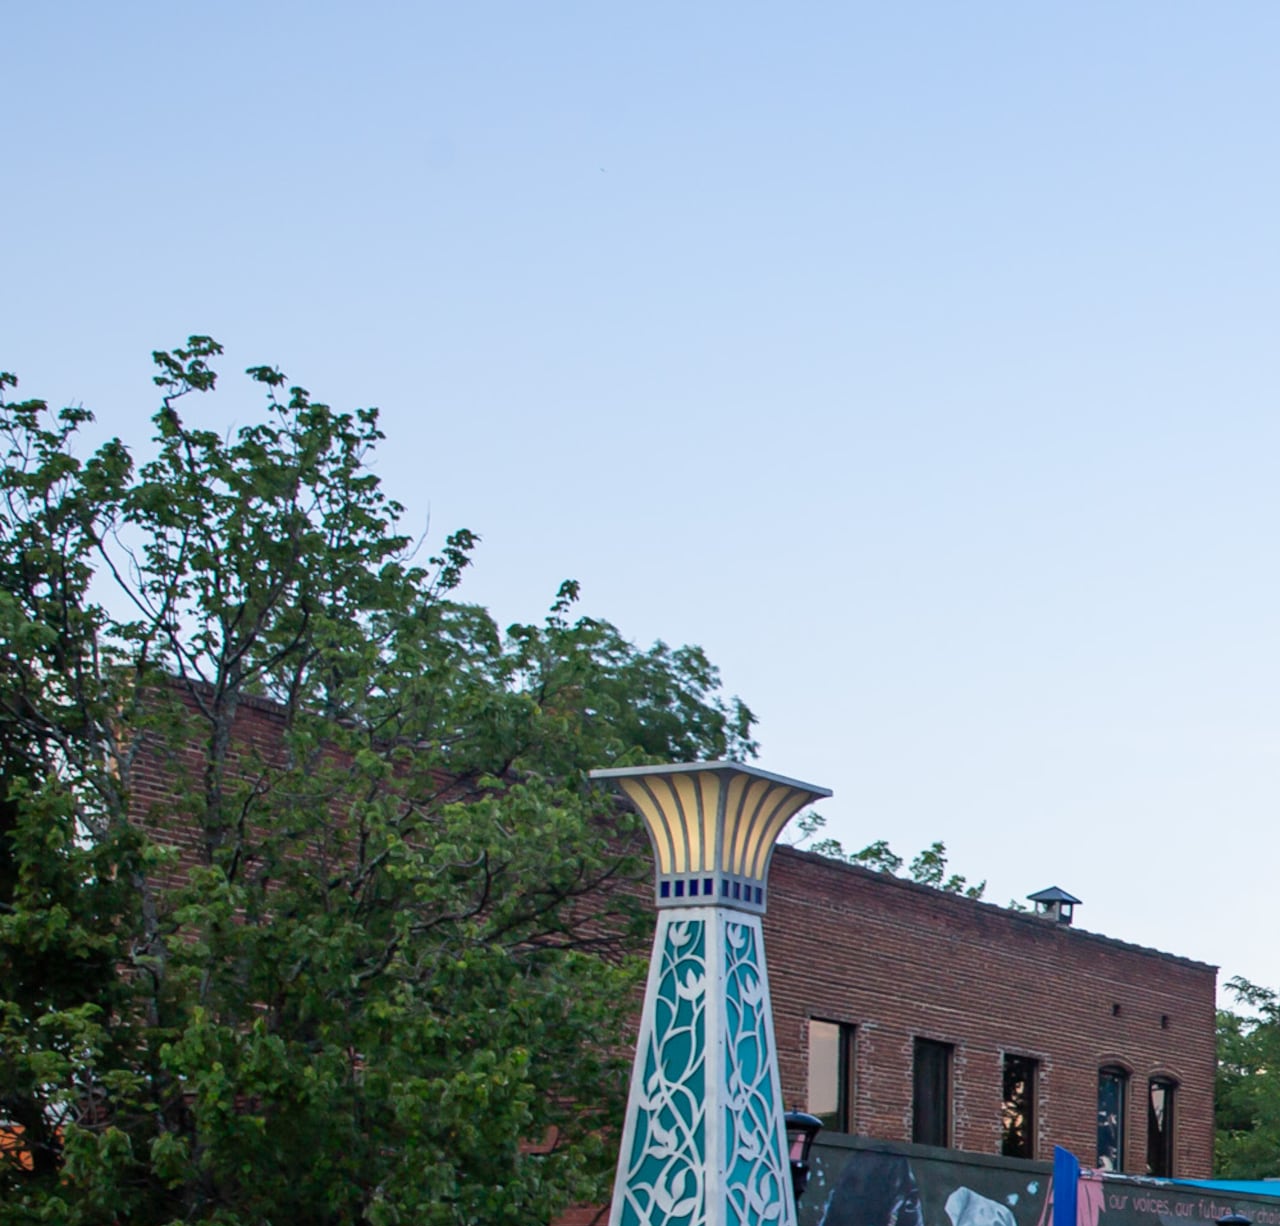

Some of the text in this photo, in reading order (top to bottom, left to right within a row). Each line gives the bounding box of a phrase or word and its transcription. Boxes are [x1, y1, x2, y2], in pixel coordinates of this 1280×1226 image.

[1109, 1194, 1128, 1210] our
[1133, 1193, 1173, 1216] voices,
[1175, 1202, 1195, 1217] our
